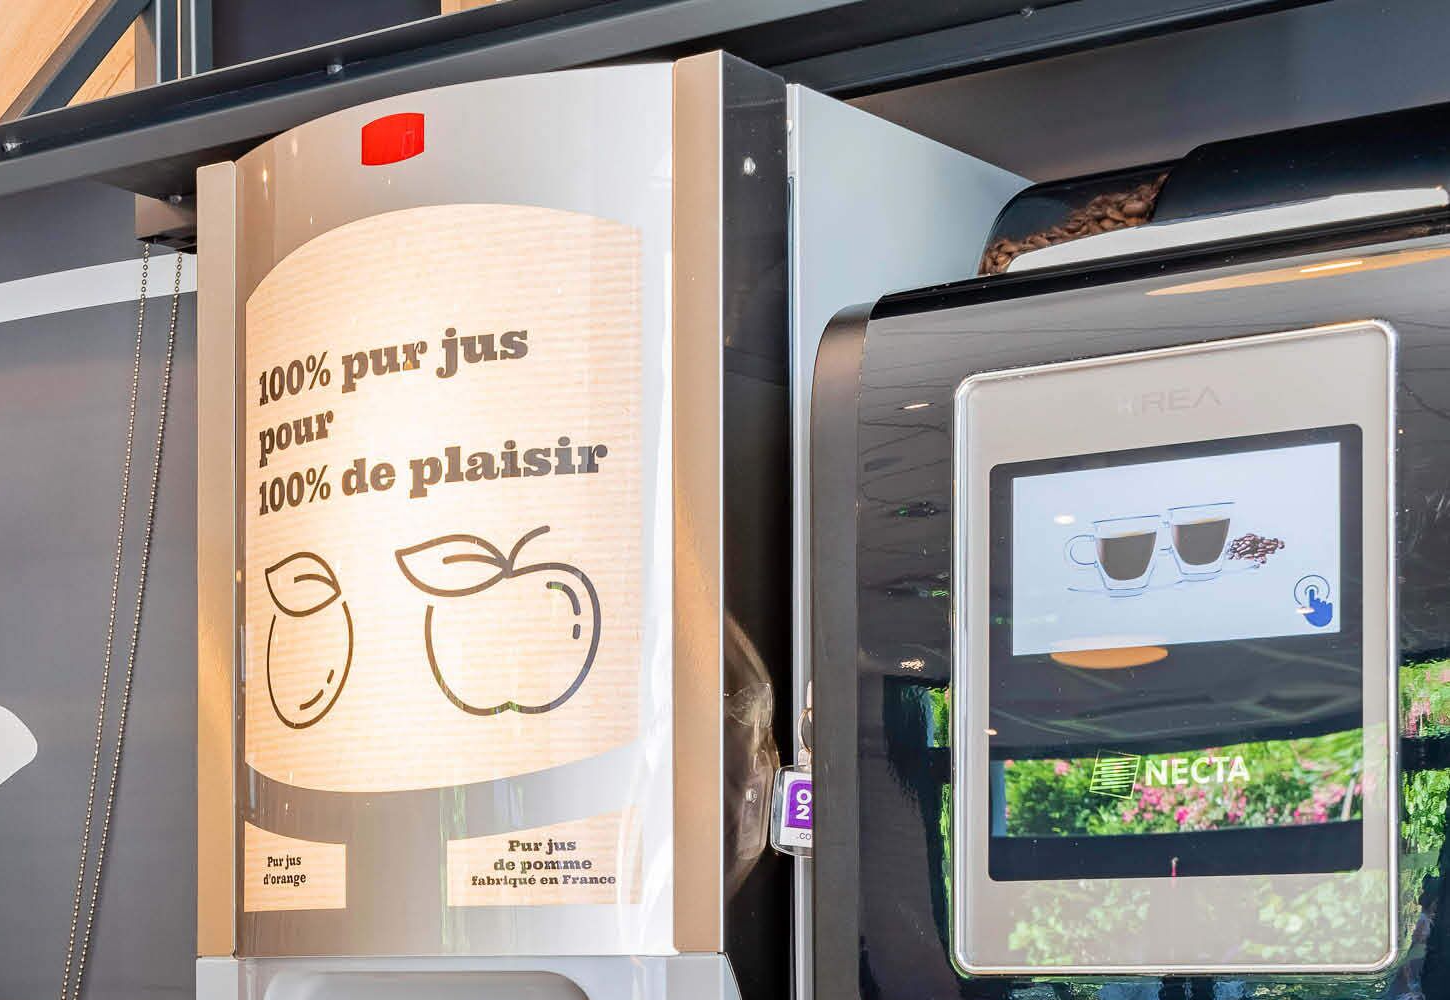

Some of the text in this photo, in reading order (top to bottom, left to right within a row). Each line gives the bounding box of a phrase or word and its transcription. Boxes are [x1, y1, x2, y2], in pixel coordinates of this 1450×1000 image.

[259, 327, 528, 406] 100% pur jus
[258, 409, 334, 468] pour
[258, 436, 608, 516] 100% de plaisir
[1145, 756, 1250, 787] NECTA
[508, 839, 577, 855] Pur jus
[267, 854, 302, 870] Pur jus
[493, 859, 593, 874] de pomme
[263, 873, 307, 887] d'orange
[471, 875, 616, 888] fabriqué en France
